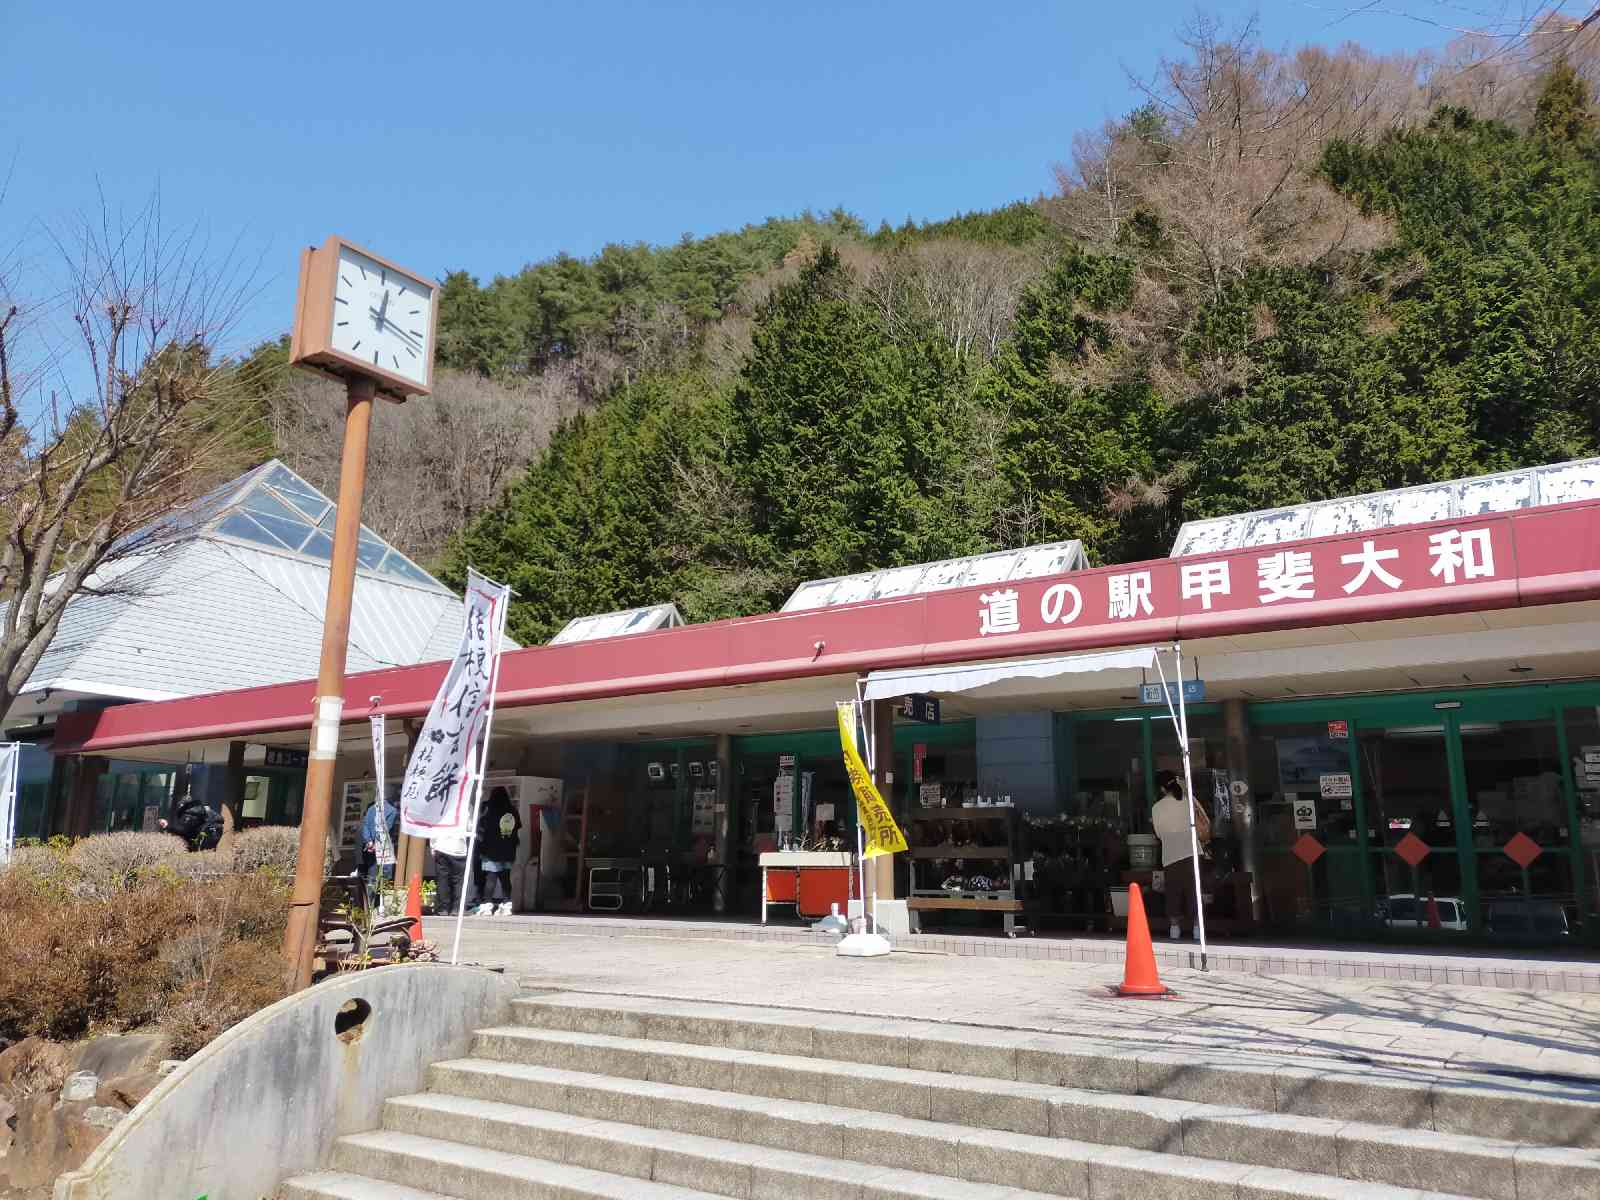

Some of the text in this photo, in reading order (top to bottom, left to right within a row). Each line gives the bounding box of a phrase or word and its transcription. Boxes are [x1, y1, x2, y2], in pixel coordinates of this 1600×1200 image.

[979, 528, 1496, 636] 道の駅甲斐大和
[424, 604, 489, 817] 桔梗信玄餅
[903, 694, 935, 721] 売店
